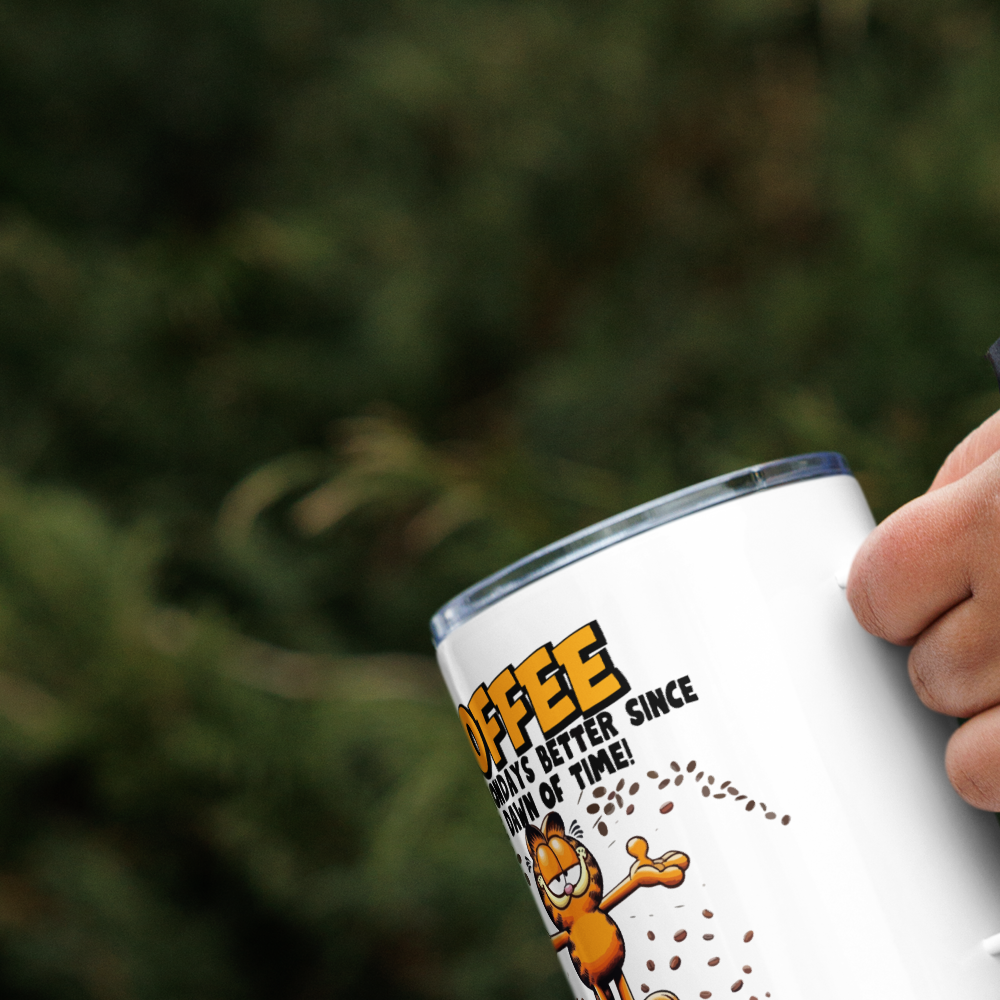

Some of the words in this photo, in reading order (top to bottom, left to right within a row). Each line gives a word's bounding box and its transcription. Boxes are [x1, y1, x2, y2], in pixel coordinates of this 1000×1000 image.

[535, 711, 619, 774] BETTER
[625, 675, 699, 727] SINCE
[502, 791, 540, 837] DAWN
[539, 773, 564, 809] OF
[568, 738, 636, 791] TIME!
